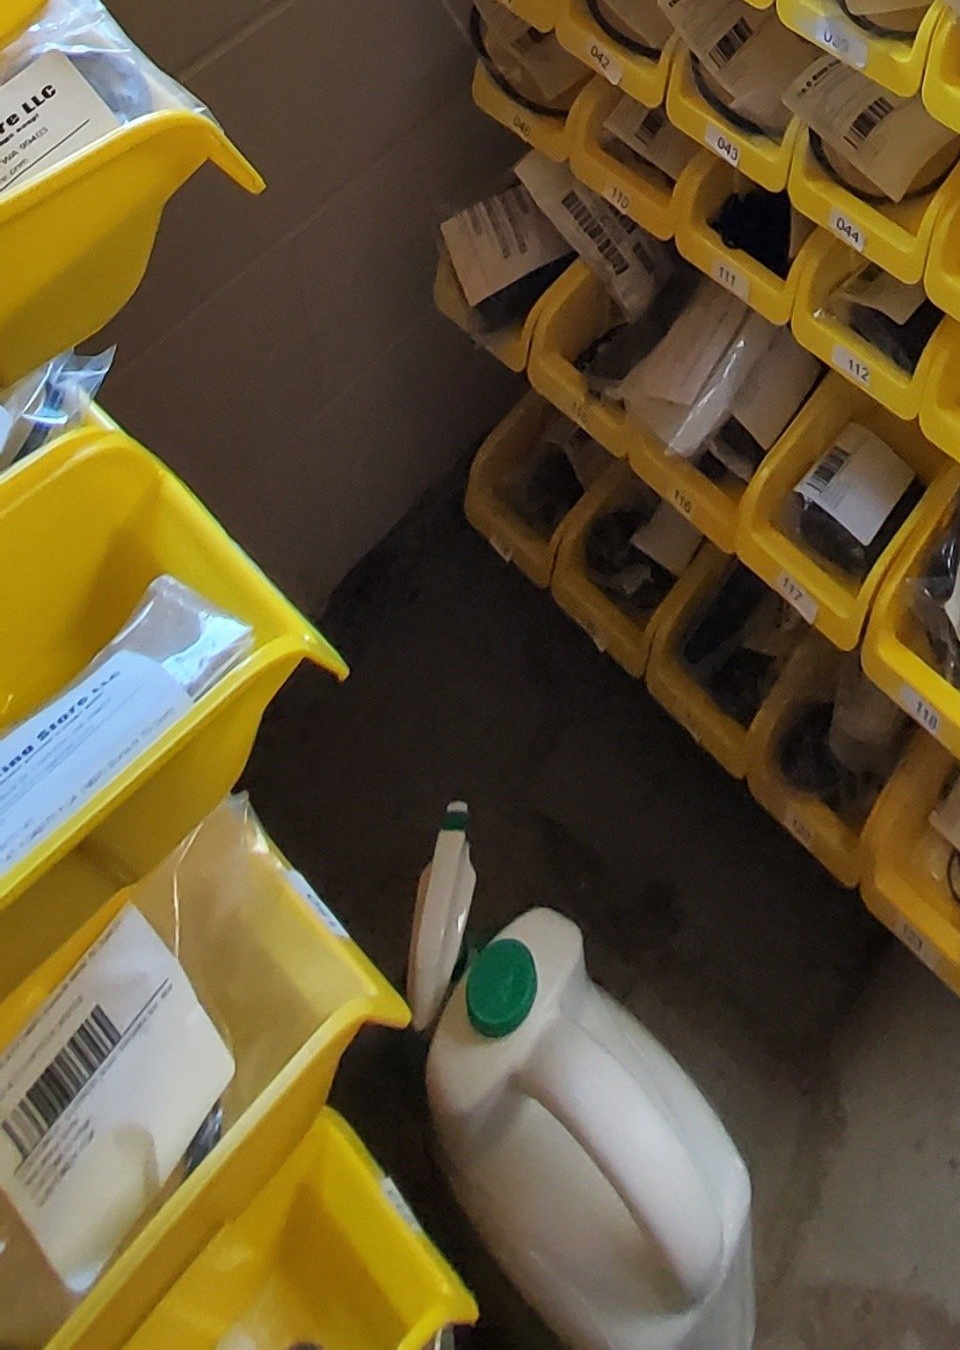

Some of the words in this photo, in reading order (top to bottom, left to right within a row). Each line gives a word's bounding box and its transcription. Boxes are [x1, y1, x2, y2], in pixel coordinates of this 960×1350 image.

[589, 44, 611, 71] 042
[21, 84, 57, 115] LLC
[716, 135, 739, 162] 043
[835, 216, 860, 244] 044
[717, 265, 736, 287] 111
[847, 358, 870, 382] 112
[781, 575, 804, 604] 117
[0, 745, 35, 779] ing
[36, 695, 89, 743] Store
